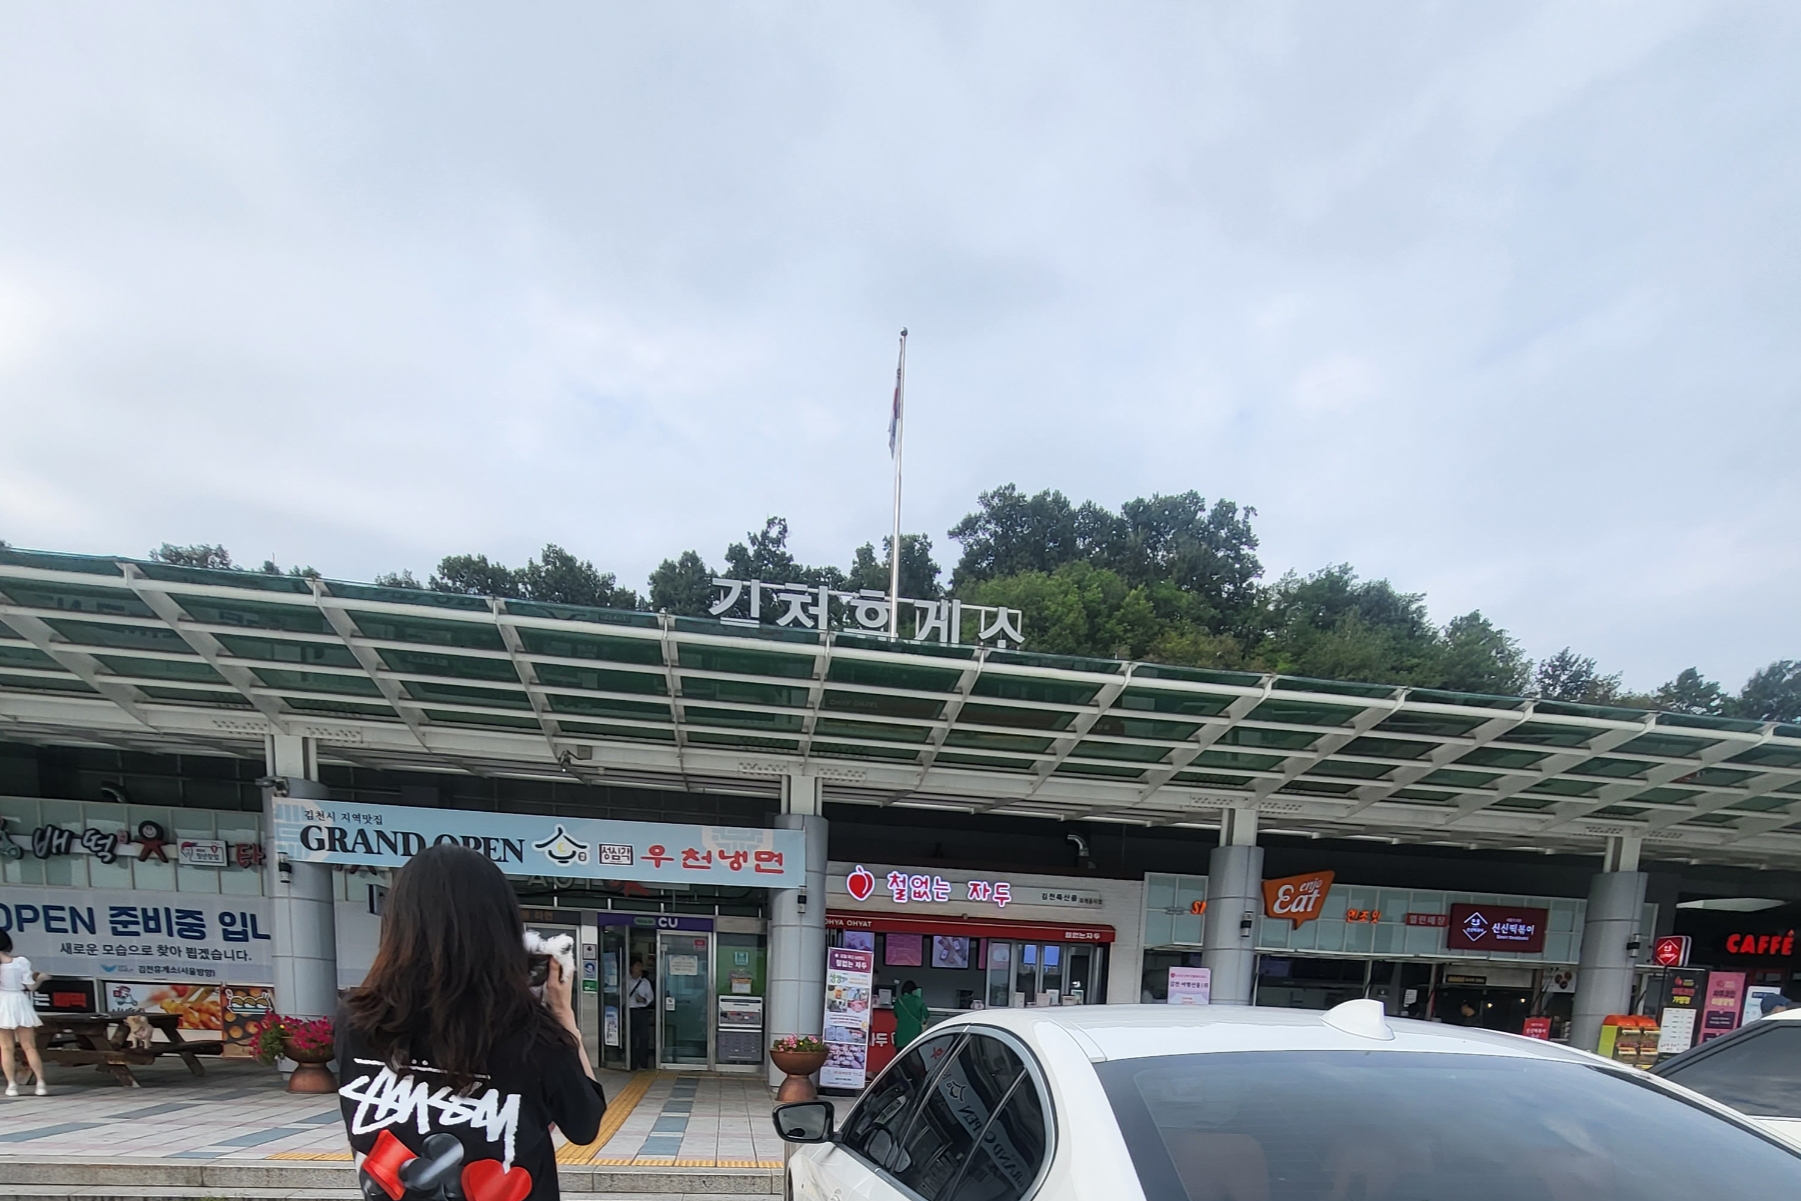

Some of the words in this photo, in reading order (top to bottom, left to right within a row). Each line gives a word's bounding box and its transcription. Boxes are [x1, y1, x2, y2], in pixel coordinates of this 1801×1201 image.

[304, 810, 336, 822] 김천시
[341, 812, 383, 825] 지역맛집
[300, 825, 426, 857] GRAND
[601, 846, 631, 861] 성심각
[641, 844, 784, 874] 우천냉면
[887, 871, 951, 902] 철없는
[967, 881, 1012, 908] 자두
[1273, 884, 1321, 914] Eat
[109, 906, 206, 940] 준비중
[657, 917, 679, 929] CU
[1491, 922, 1535, 935] 신신떡볶이
[60, 943, 98, 956] 새로운
[102, 944, 152, 957] 모습으로
[157, 945, 182, 958] 찾아
[185, 947, 252, 962] 뵙겠습니다.
